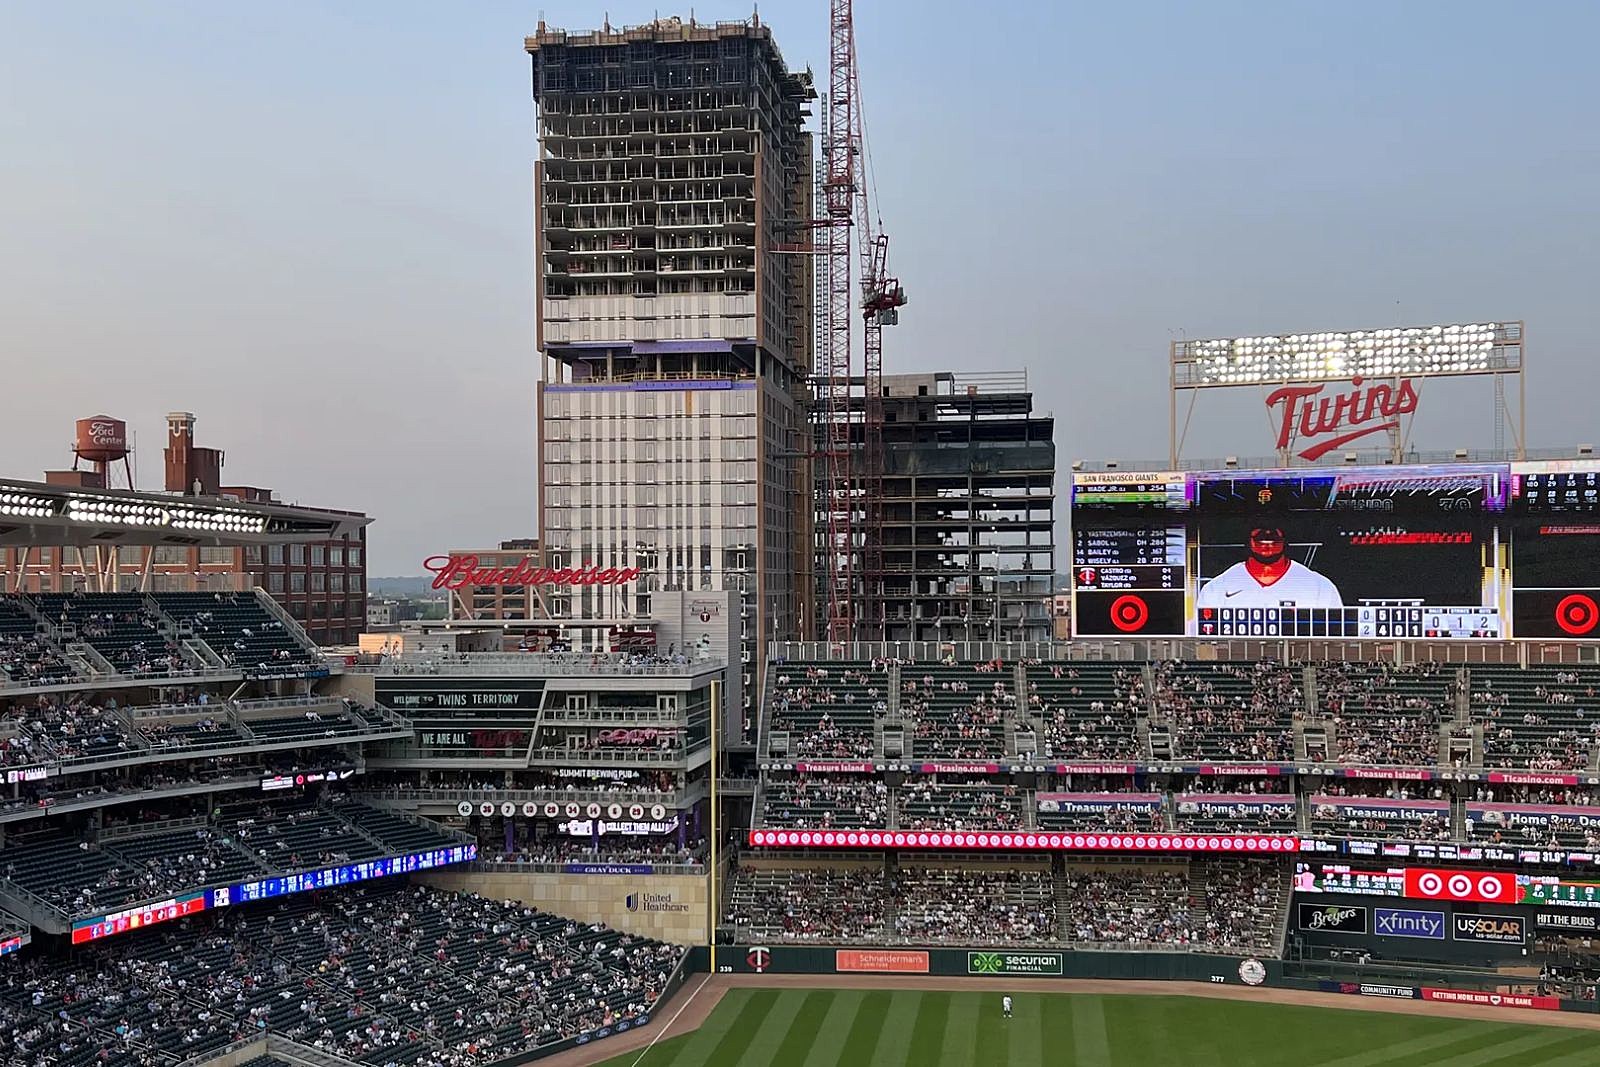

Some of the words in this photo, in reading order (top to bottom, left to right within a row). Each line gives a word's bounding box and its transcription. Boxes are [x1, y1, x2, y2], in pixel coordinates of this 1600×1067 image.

[1265, 375, 1418, 455] Twins
[88, 421, 114, 436] Ford
[93, 435, 122, 445] Center
[1084, 474, 1097, 482] SAN
[1098, 474, 1133, 482] FRANCISCO
[1135, 473, 1159, 482] GIANTS
[423, 553, 641, 589] Budweiser
[1222, 609, 1231, 620] 0
[1238, 609, 1246, 620] 0
[1253, 609, 1261, 620] 0
[1268, 609, 1277, 620] 0
[1363, 610, 1370, 620] 0
[1395, 610, 1402, 621] 1
[1432, 616, 1440, 628] 0
[1457, 616, 1463, 629] 1
[1480, 616, 1488, 629] 2
[1223, 624, 1231, 634] 2
[1238, 624, 1246, 635] 0
[1253, 624, 1261, 635] 0
[1268, 624, 1277, 635] 0
[1363, 625, 1370, 635] 2
[1378, 625, 1387, 636] 4
[1395, 625, 1403, 635] 0
[1411, 625, 1418, 636] 1
[393, 695, 420, 704] WELCOME
[437, 694, 467, 706] TWINS
[471, 694, 519, 704] TERRITORY
[422, 732, 435, 744] WE
[436, 732, 450, 744] ARE
[452, 732, 466, 744] ALL
[804, 763, 839, 772] Treasure
[841, 763, 865, 772] Island
[1064, 765, 1101, 774] Treasure
[1102, 765, 1128, 774] Island
[559, 768, 586, 778] SUMMIT
[587, 769, 618, 779] BREWING
[618, 769, 633, 778] PUB
[1353, 769, 1394, 779] Treasure
[1395, 770, 1423, 780] Island
[460, 805, 470, 813] 42
[505, 805, 511, 813] 7
[632, 807, 641, 815] 29
[1343, 807, 1399, 818] Treasure
[1510, 813, 1548, 825] Home
[606, 822, 633, 832] COLLECT
[633, 822, 650, 832] THEM
[1485, 848, 1503, 860] 75.7
[584, 866, 607, 874] GRAY
[607, 866, 632, 874] DUCK
[643, 893, 672, 902] United
[643, 902, 689, 912] Healthcare
[1308, 908, 1357, 930] Breyers
[1379, 912, 1441, 935] xfinity
[1537, 913, 1552, 924] HIT
[1552, 914, 1570, 925] THE
[1570, 916, 1596, 927] BUDS
[1475, 932, 1521, 941] us-solar.com
[859, 953, 924, 964] Schneiderman's
[1005, 954, 1057, 966] securian
[1210, 975, 1225, 983] 377
[1360, 985, 1397, 996] COMMUNITY
[1397, 988, 1413, 997] FUND
[1457, 992, 1474, 1002] MORE
[1503, 996, 1515, 1005] THE
[1515, 997, 1532, 1006] GAME
